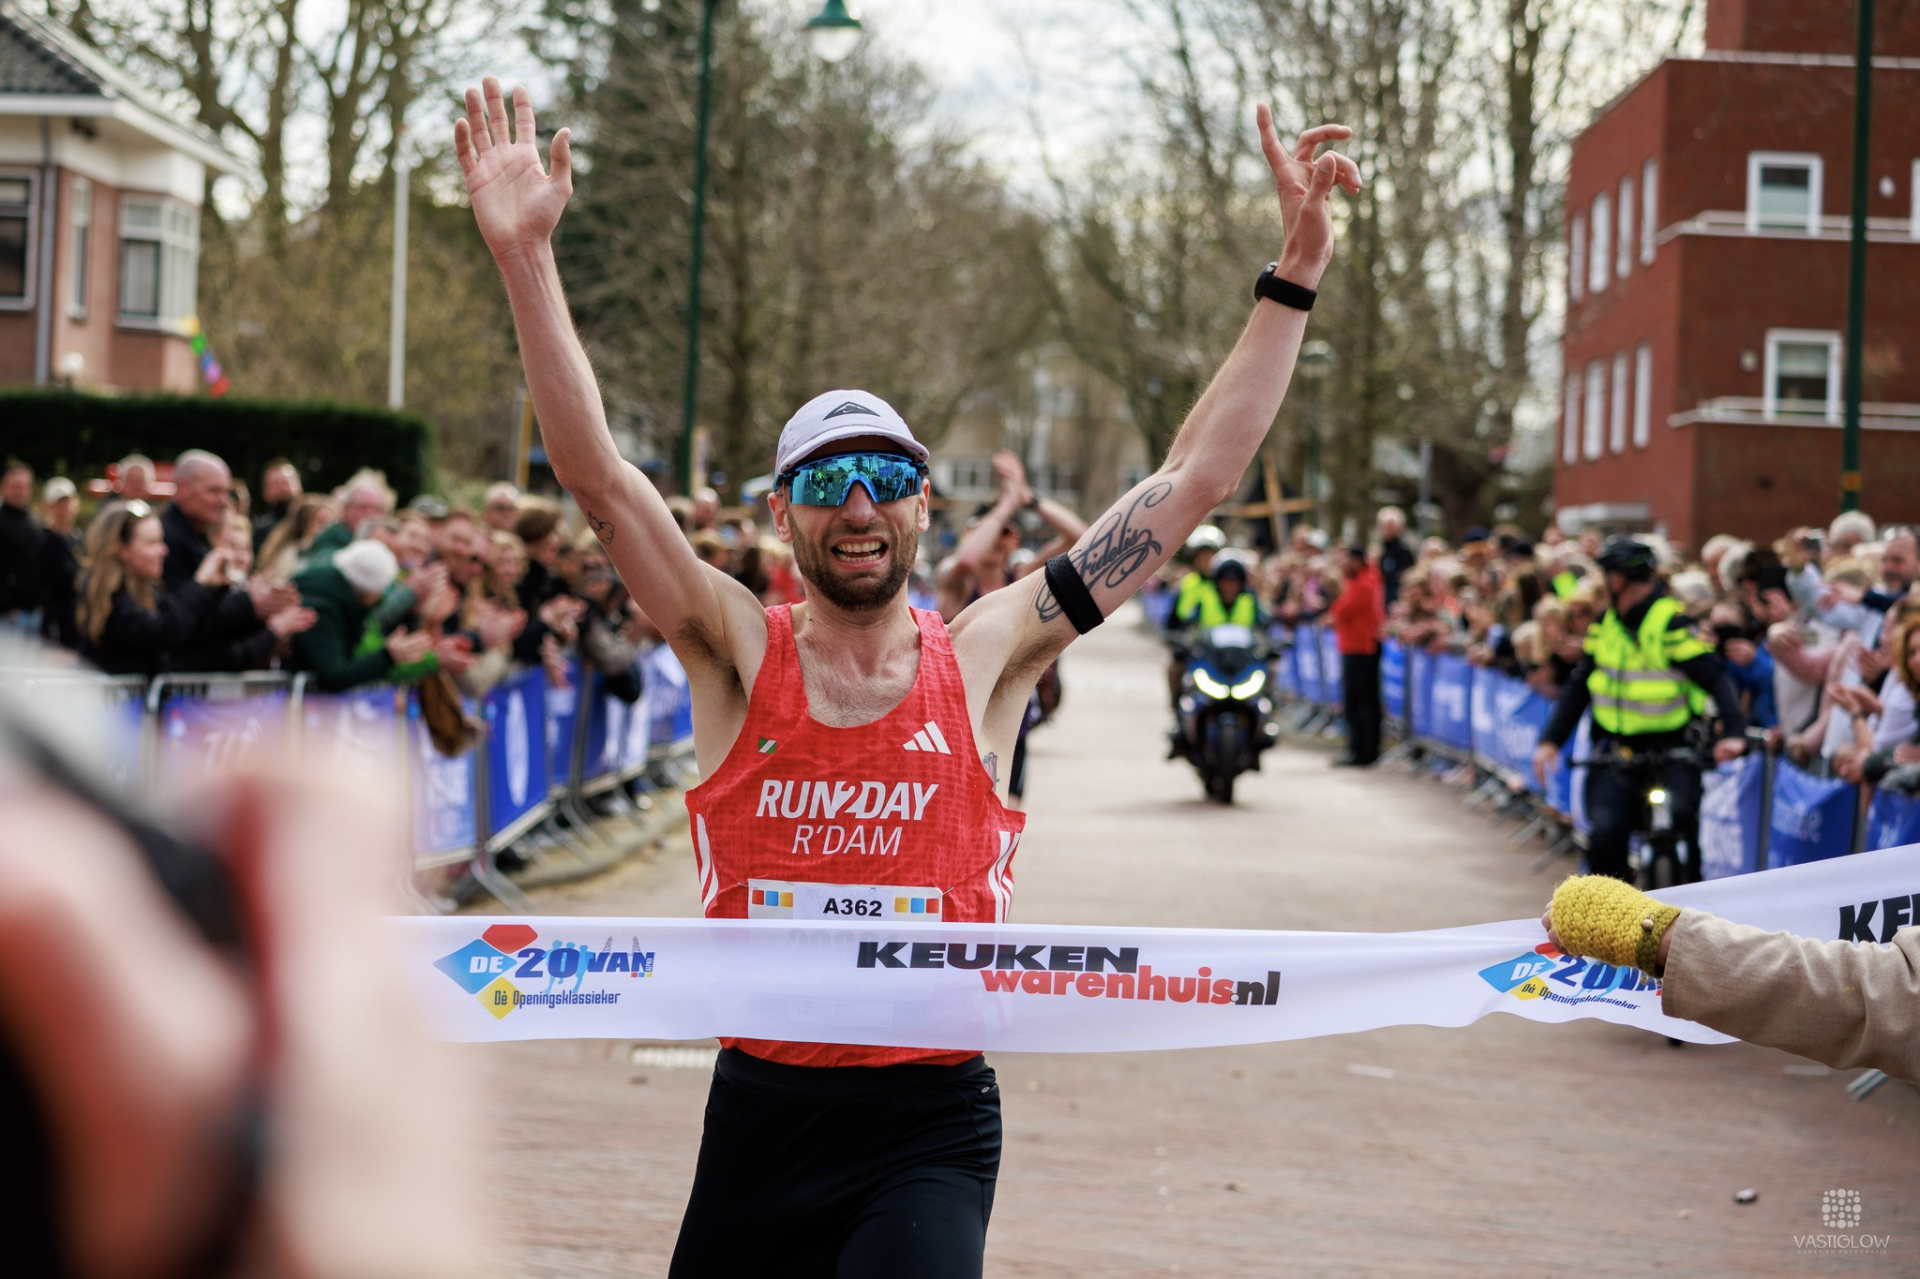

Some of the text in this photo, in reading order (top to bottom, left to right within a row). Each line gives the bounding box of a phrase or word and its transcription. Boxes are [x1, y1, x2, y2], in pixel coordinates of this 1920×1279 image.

[756, 779, 939, 821] RUN2DAY
[791, 824, 903, 856] R'DAM
[823, 897, 882, 917] A362
[1838, 893, 1920, 944] KE
[469, 947, 655, 979] DE 20 VAN
[856, 941, 1140, 973] KEUKEN
[1510, 954, 1662, 992] DE 20 VA
[513, 989, 621, 1009] Openingsklassieker
[1538, 986, 1641, 1010] Openingsklassieker
